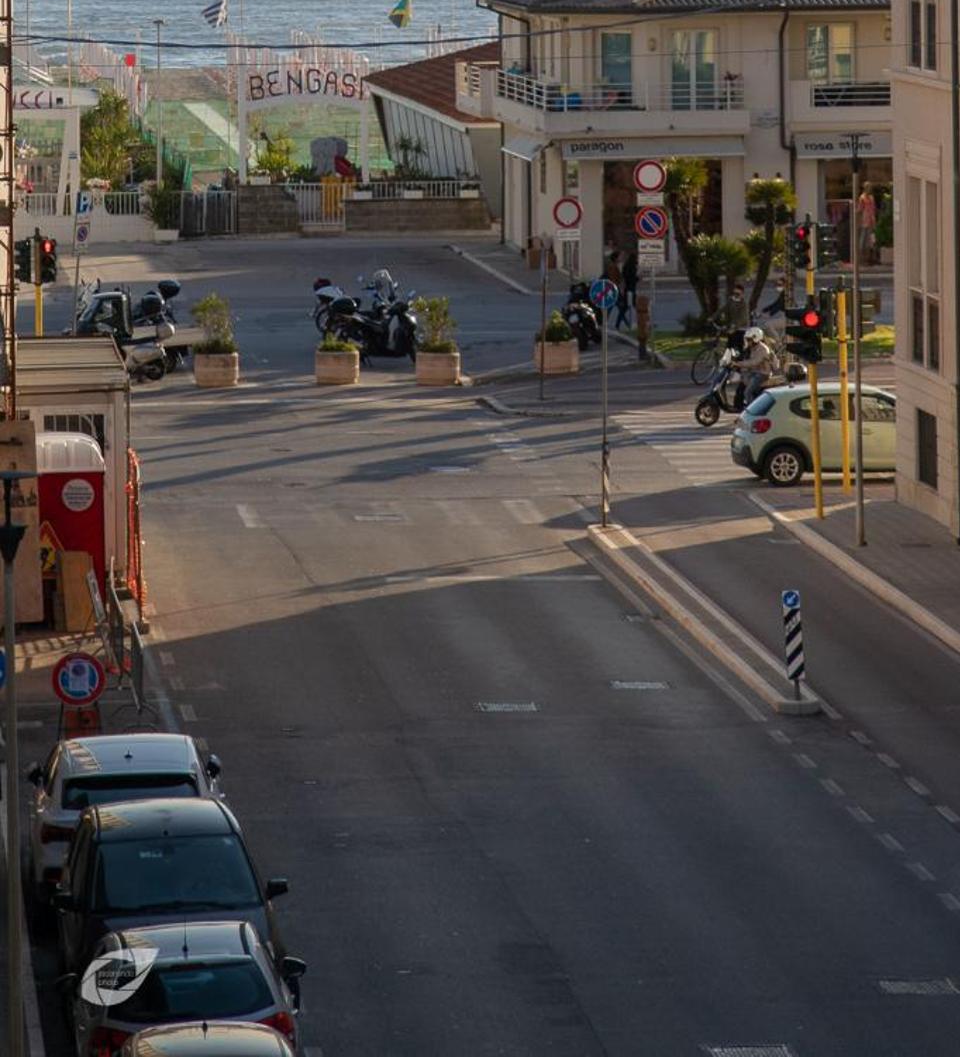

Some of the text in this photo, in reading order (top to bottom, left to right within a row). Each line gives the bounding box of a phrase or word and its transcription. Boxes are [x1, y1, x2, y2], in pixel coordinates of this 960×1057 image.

[249, 68, 364, 101] BENGASI
[13, 90, 53, 110] CCI
[570, 142, 625, 153] paragon
[839, 141, 873, 151] stre
